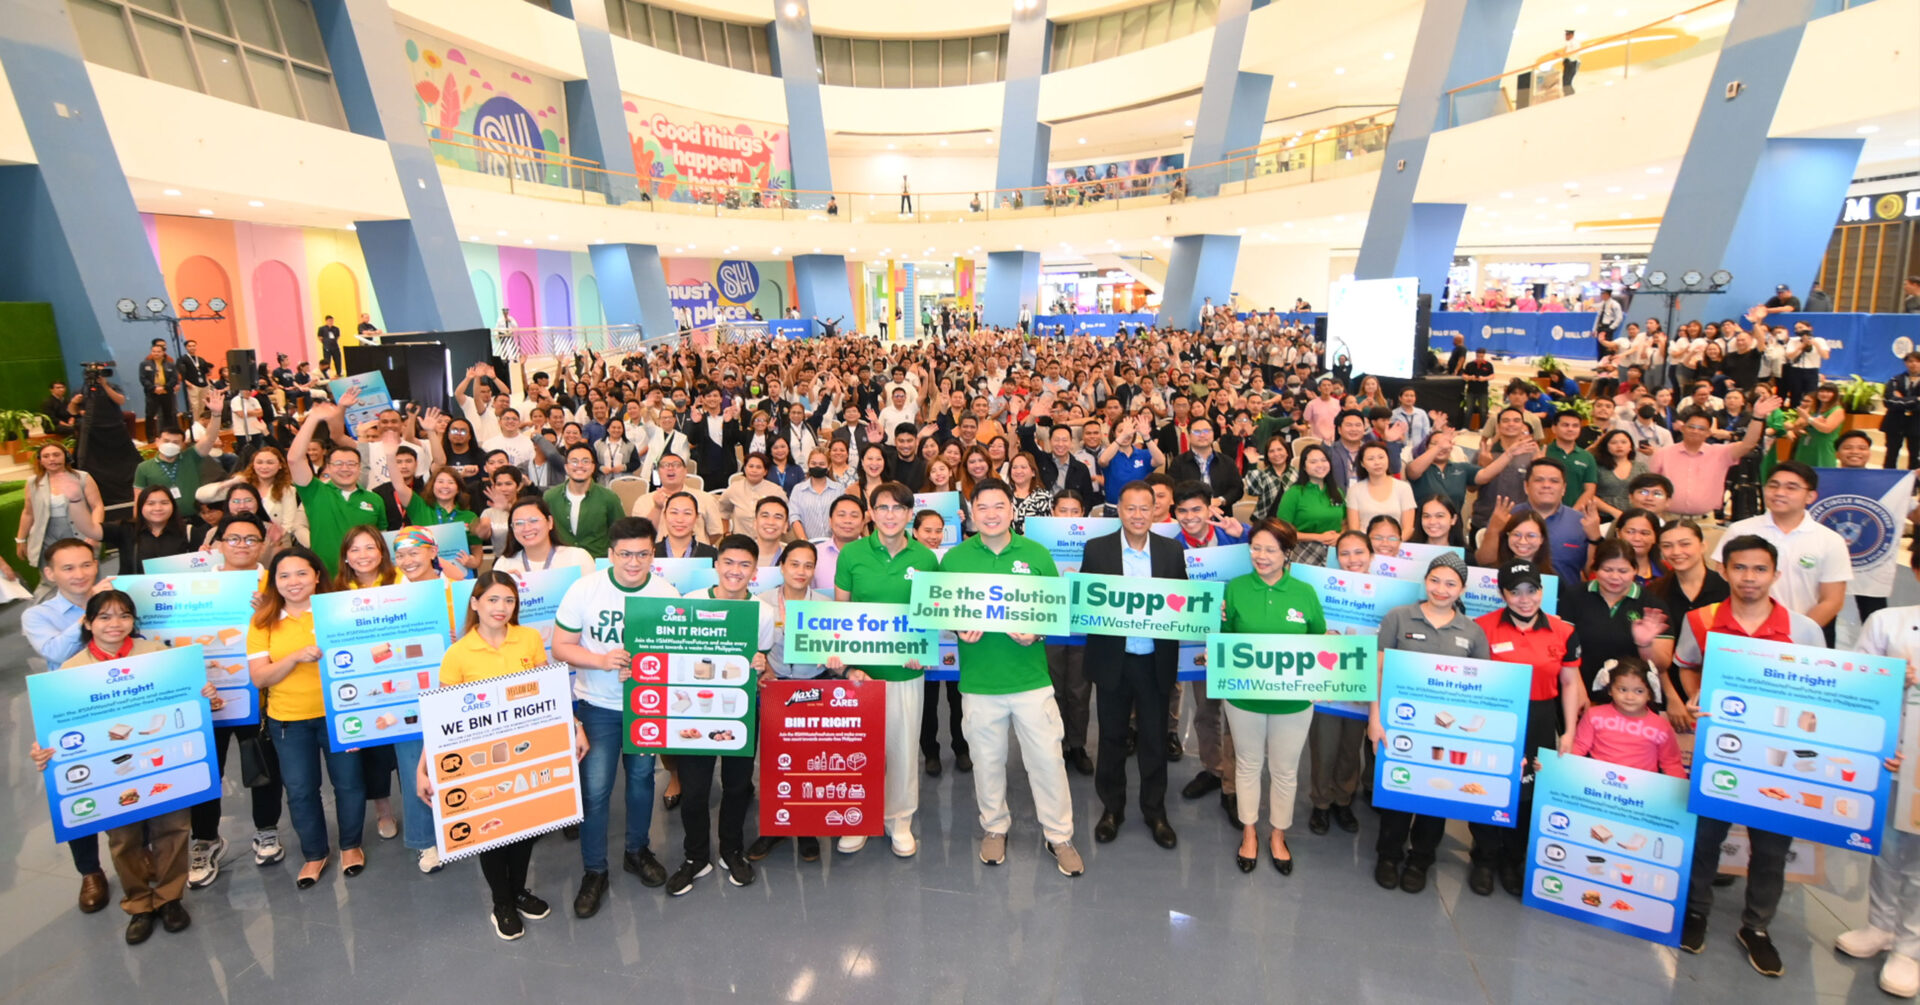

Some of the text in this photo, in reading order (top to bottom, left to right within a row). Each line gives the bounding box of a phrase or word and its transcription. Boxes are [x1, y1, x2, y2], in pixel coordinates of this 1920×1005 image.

[652, 115, 763, 157] Good things
[672, 142, 743, 175] happen
[1195, 571, 1217, 580] right!
[1511, 563, 1530, 573] KFC
[929, 585, 1067, 605] Be the Solution
[1072, 581, 1080, 605] I
[1464, 591, 1479, 600] Bin
[154, 599, 213, 611] Bin it right!
[912, 601, 1058, 623] Join the Mission
[1324, 595, 1375, 612] Bin it right!
[354, 612, 407, 627] Bin it right!
[662, 614, 687, 622] CARES
[797, 612, 803, 629] I
[808, 615, 853, 631] care
[857, 613, 889, 632] for
[1070, 614, 1211, 634] #SMWasteFreeFuture
[656, 626, 728, 637] BIN IT RIGHT!
[794, 633, 929, 655] Environment
[1217, 642, 1225, 668] I
[1435, 664, 1459, 673] KFC
[106, 674, 135, 685] CARES
[1217, 678, 1367, 693] #SMWasteFreeFuture
[1427, 677, 1482, 693] Bin it right!
[1762, 667, 1837, 690] Bin it right!
[89, 681, 155, 703] Bin it right!
[784, 688, 821, 706] Max's
[461, 700, 491, 713] CARES
[829, 699, 858, 707] CARES
[440, 720, 464, 736] WE
[467, 713, 493, 730] BIN
[496, 709, 510, 723] IT
[512, 698, 557, 719] RIGHT!
[784, 717, 861, 728] BIN IT RIGHT!
[1590, 715, 1668, 744] adidas
[1601, 779, 1629, 790] CARES
[1582, 786, 1644, 810] Bin it right!
